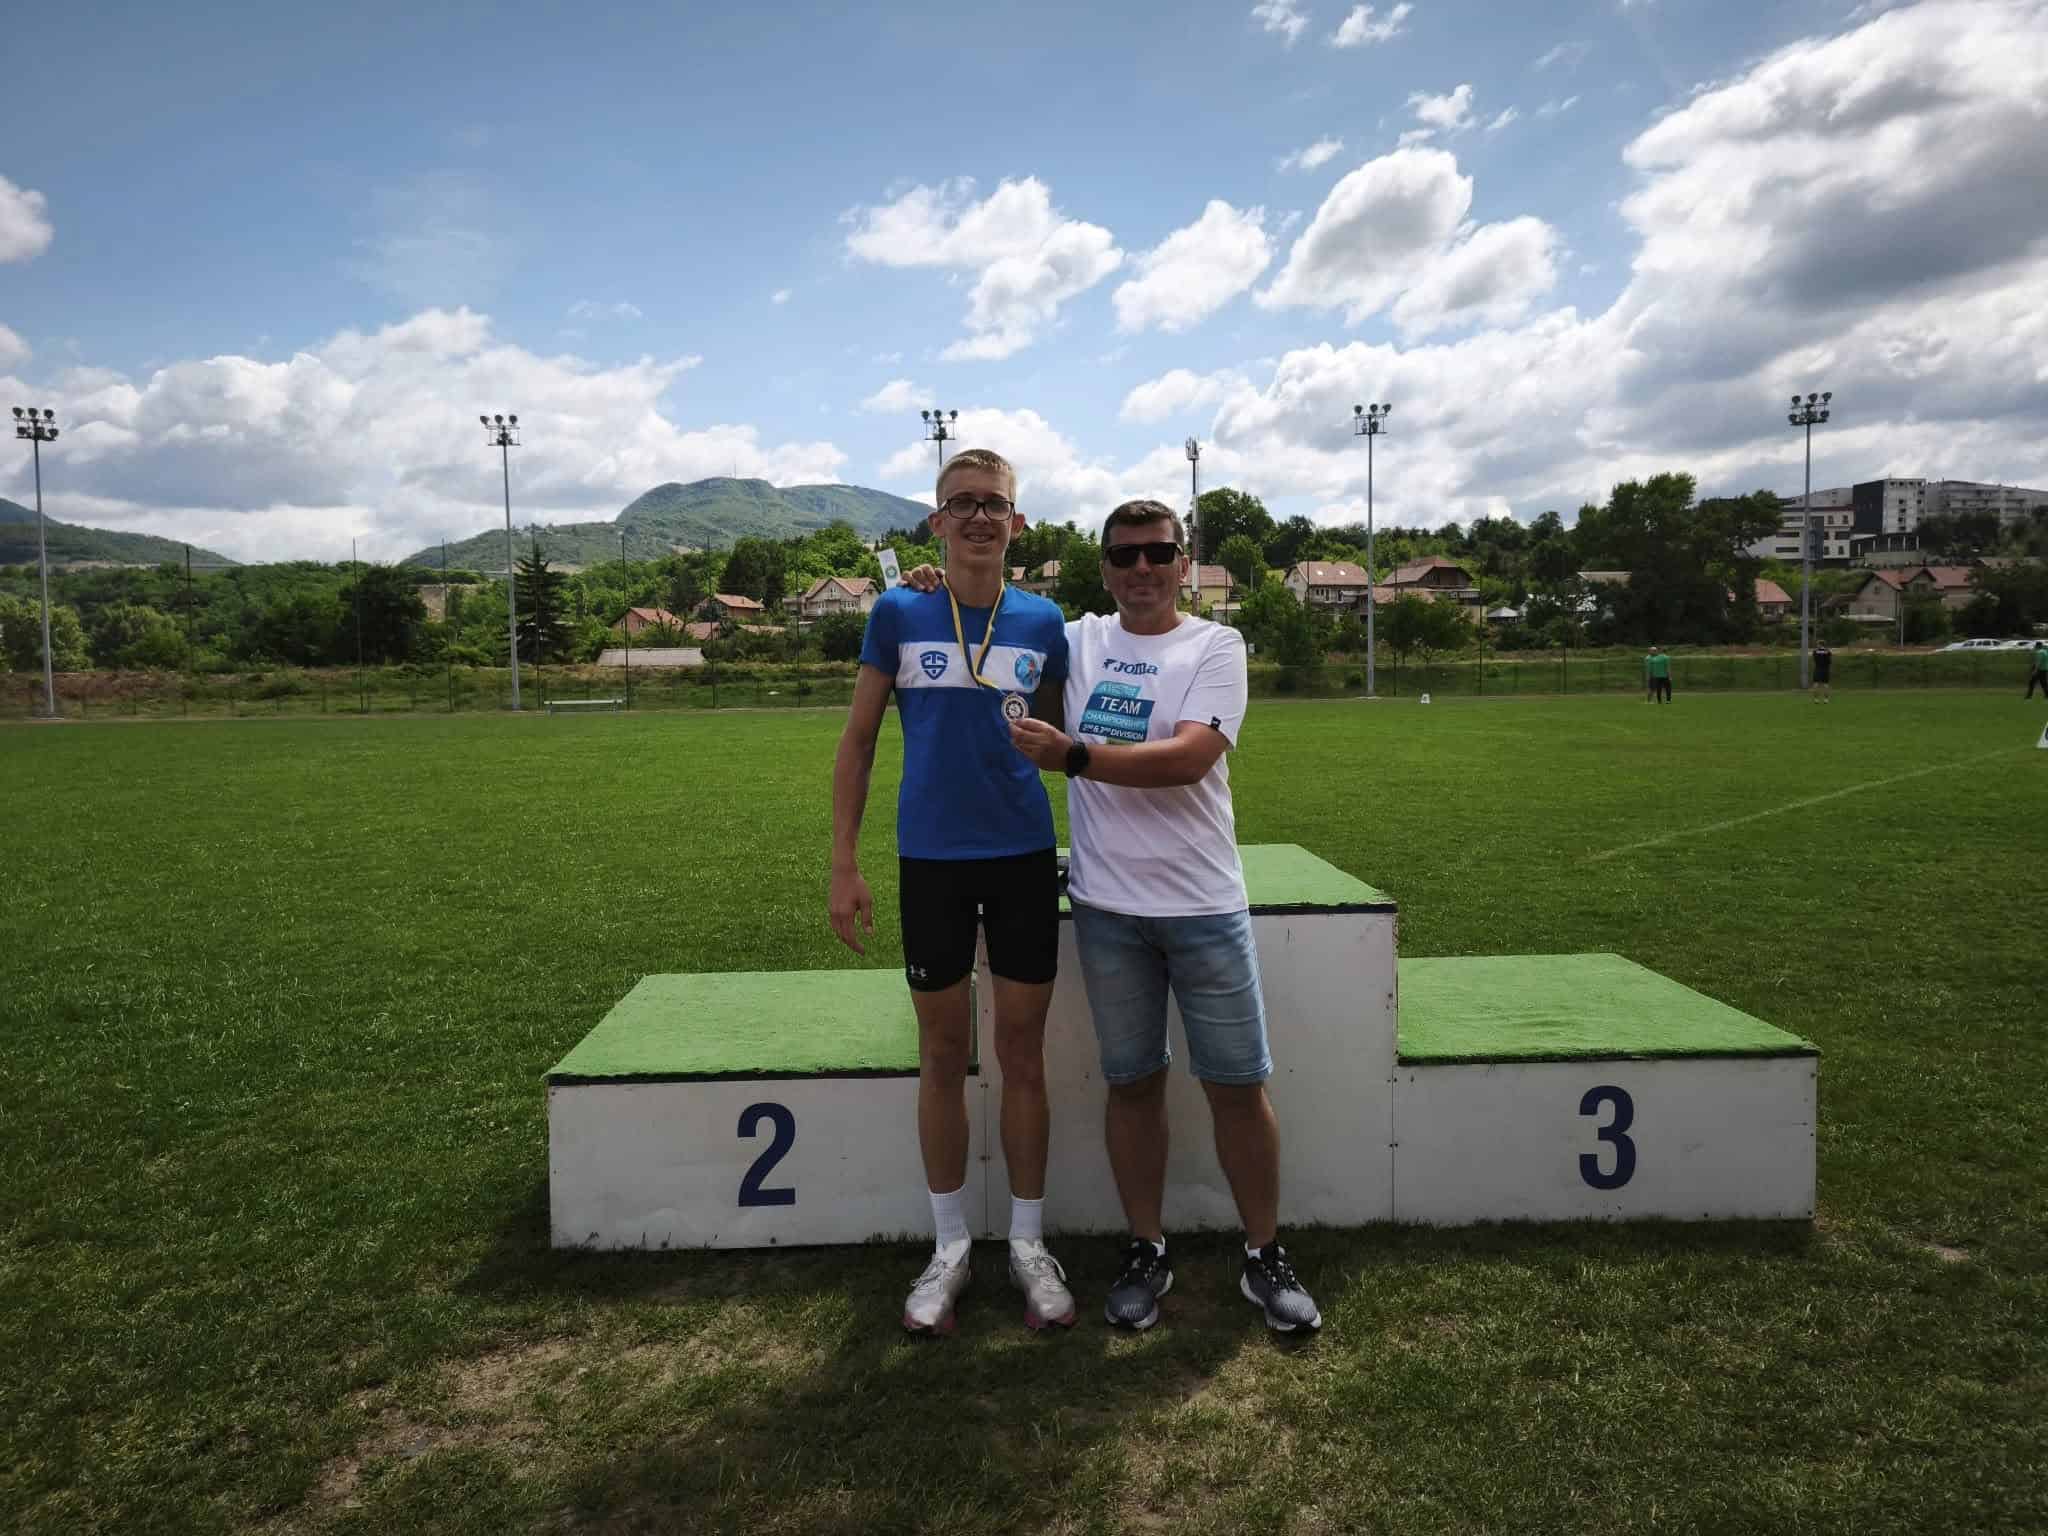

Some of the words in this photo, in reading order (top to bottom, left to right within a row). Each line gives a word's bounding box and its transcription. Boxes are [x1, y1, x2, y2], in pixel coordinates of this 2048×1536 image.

[1100, 696, 1142, 716] TEAM
[1111, 728, 1145, 740] DIVISION
[737, 1102, 796, 1207] 2
[1578, 1085, 1636, 1190] 3
